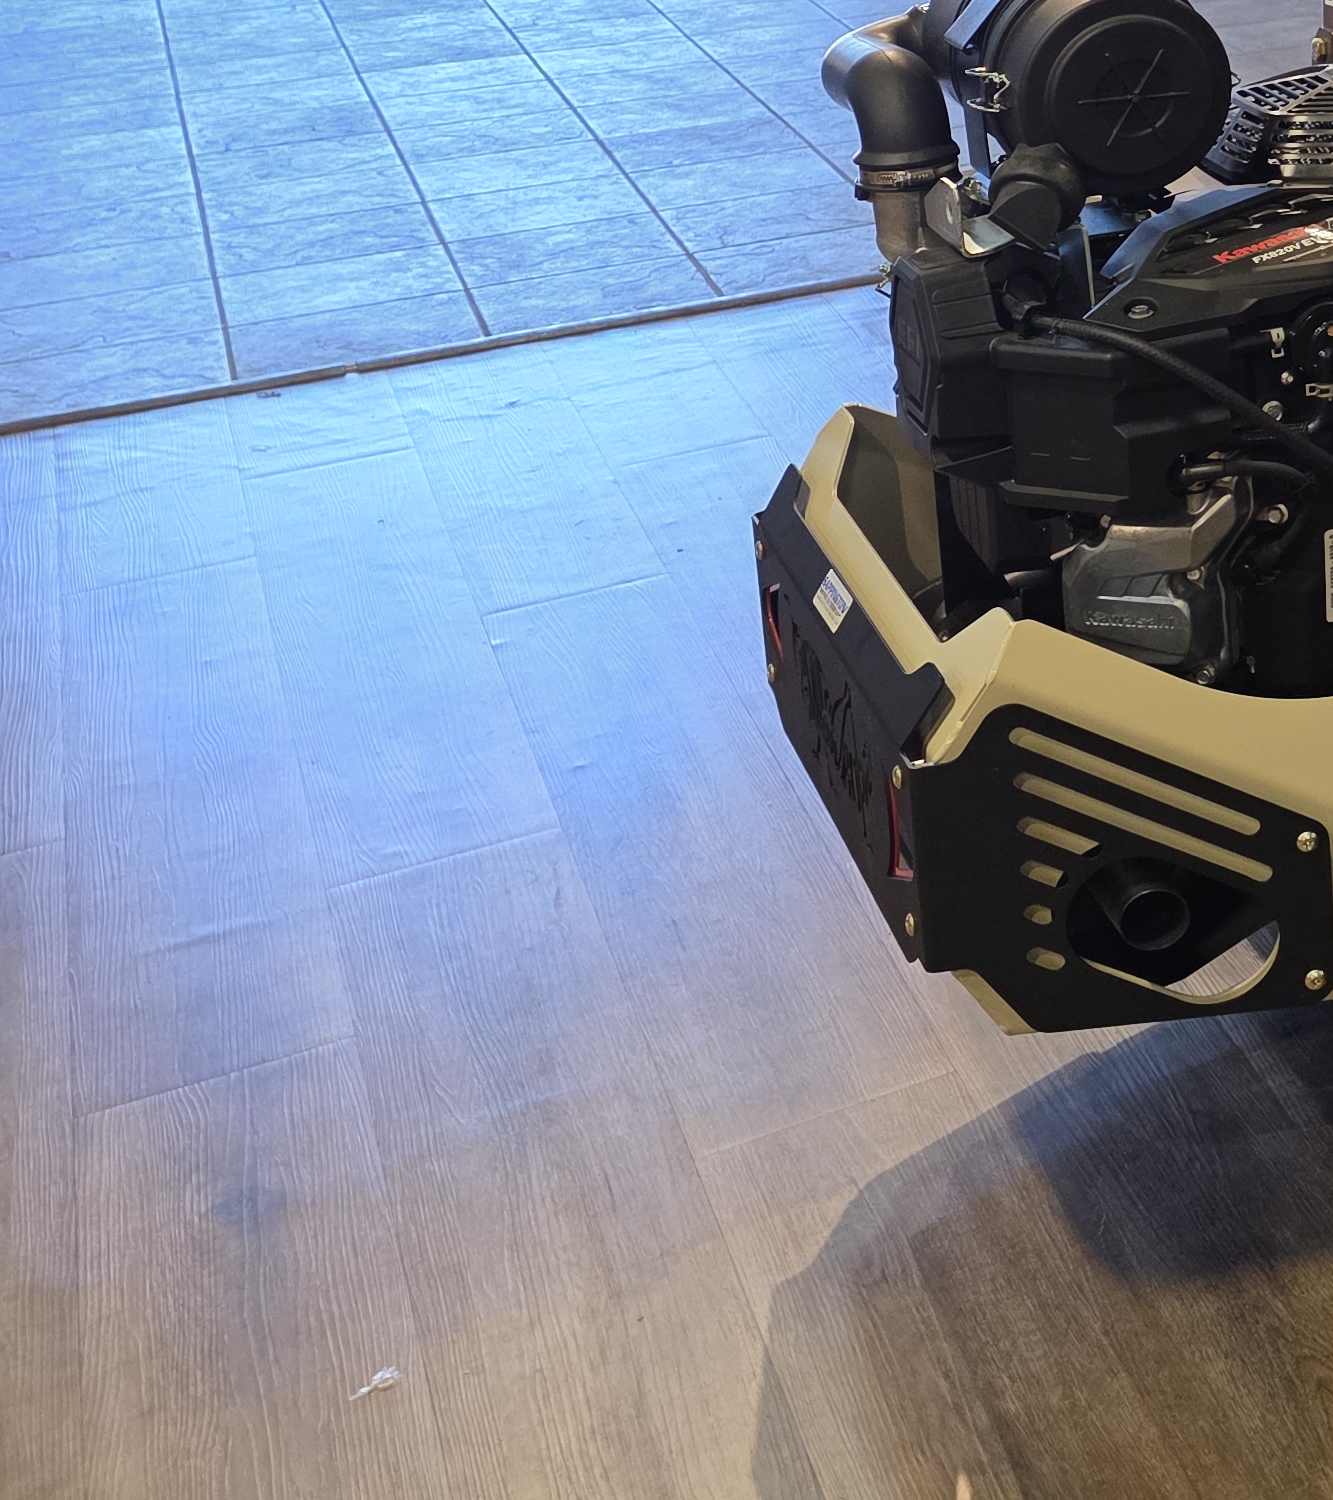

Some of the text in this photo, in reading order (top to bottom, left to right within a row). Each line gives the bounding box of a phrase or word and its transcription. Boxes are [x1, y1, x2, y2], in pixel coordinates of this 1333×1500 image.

[1212, 223, 1324, 264] Kawasa
[1251, 241, 1301, 264] FX820V
[1083, 609, 1176, 630] Kawasaki
